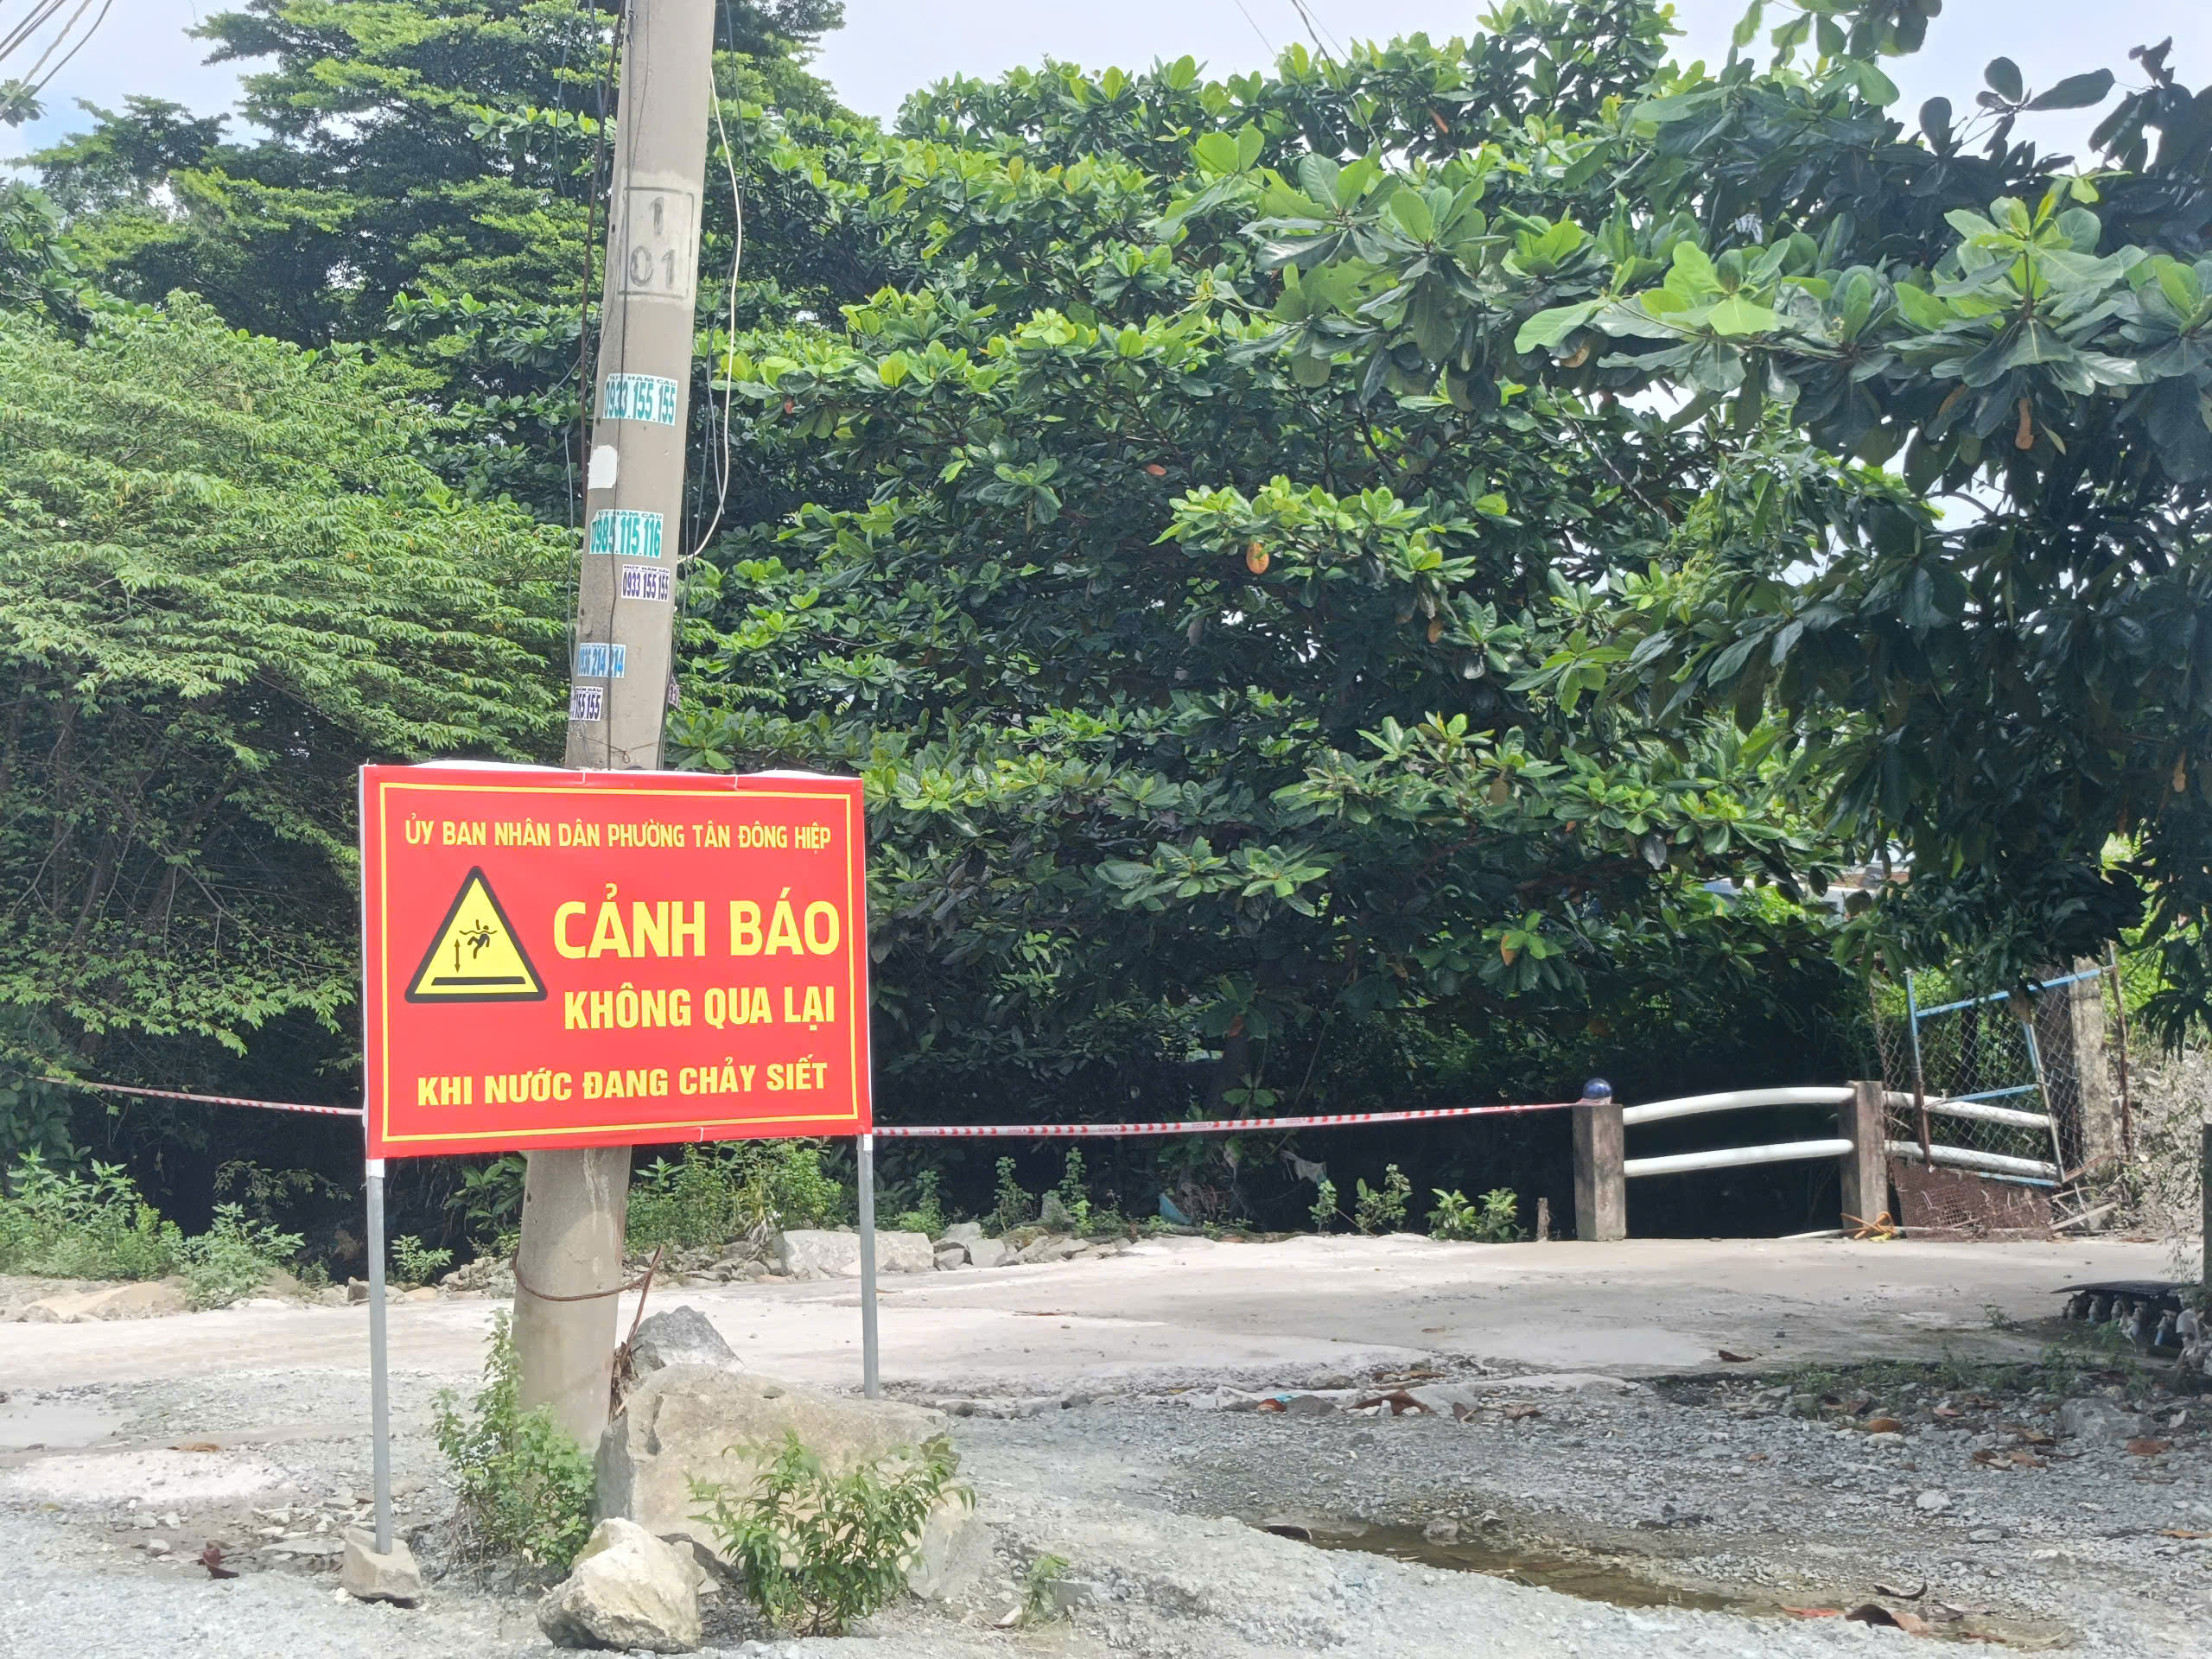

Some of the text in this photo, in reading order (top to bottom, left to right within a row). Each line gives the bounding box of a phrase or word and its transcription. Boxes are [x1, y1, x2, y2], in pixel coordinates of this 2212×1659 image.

[649, 196, 664, 235] 1
[629, 245, 675, 289] 01
[404, 812, 831, 855] ỦY BAN NHÂN DÂN PHƯỜNG TÂN ĐÔNG HIỆP
[553, 882, 840, 959] CẢNH BÁO
[564, 982, 836, 1032] KHÔNG QUA LẠI
[417, 1053, 828, 1107] KHI NƯỚC ĐANG CHẢY SIẾT
